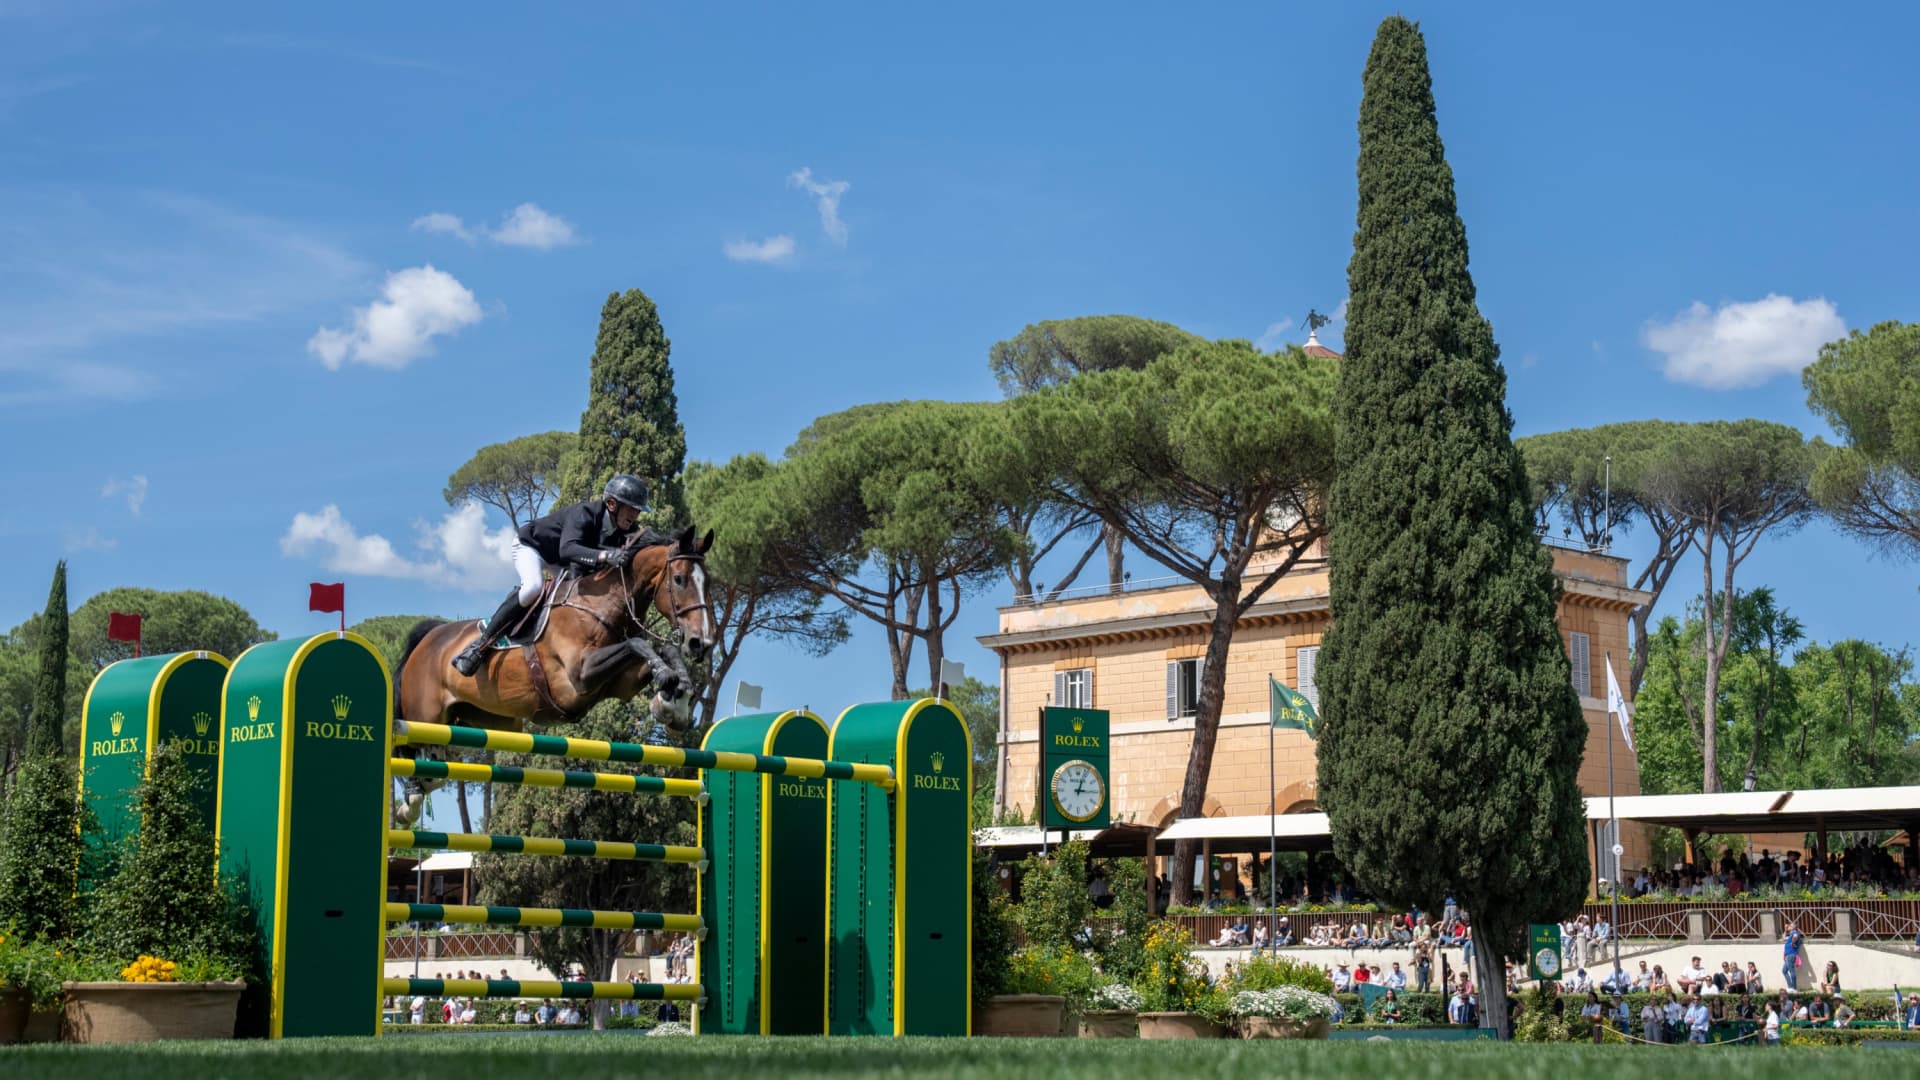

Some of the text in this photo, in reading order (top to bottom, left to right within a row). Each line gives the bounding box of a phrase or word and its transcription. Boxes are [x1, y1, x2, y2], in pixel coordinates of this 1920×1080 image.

[230, 722, 275, 743] ROLEX
[305, 721, 374, 741] ROLEX
[92, 737, 139, 756] ROLEX
[169, 738, 219, 755] ROLE
[1055, 734, 1100, 747] ROLEX
[779, 783, 826, 799] ROLEX
[914, 774, 961, 791] ROLEX
